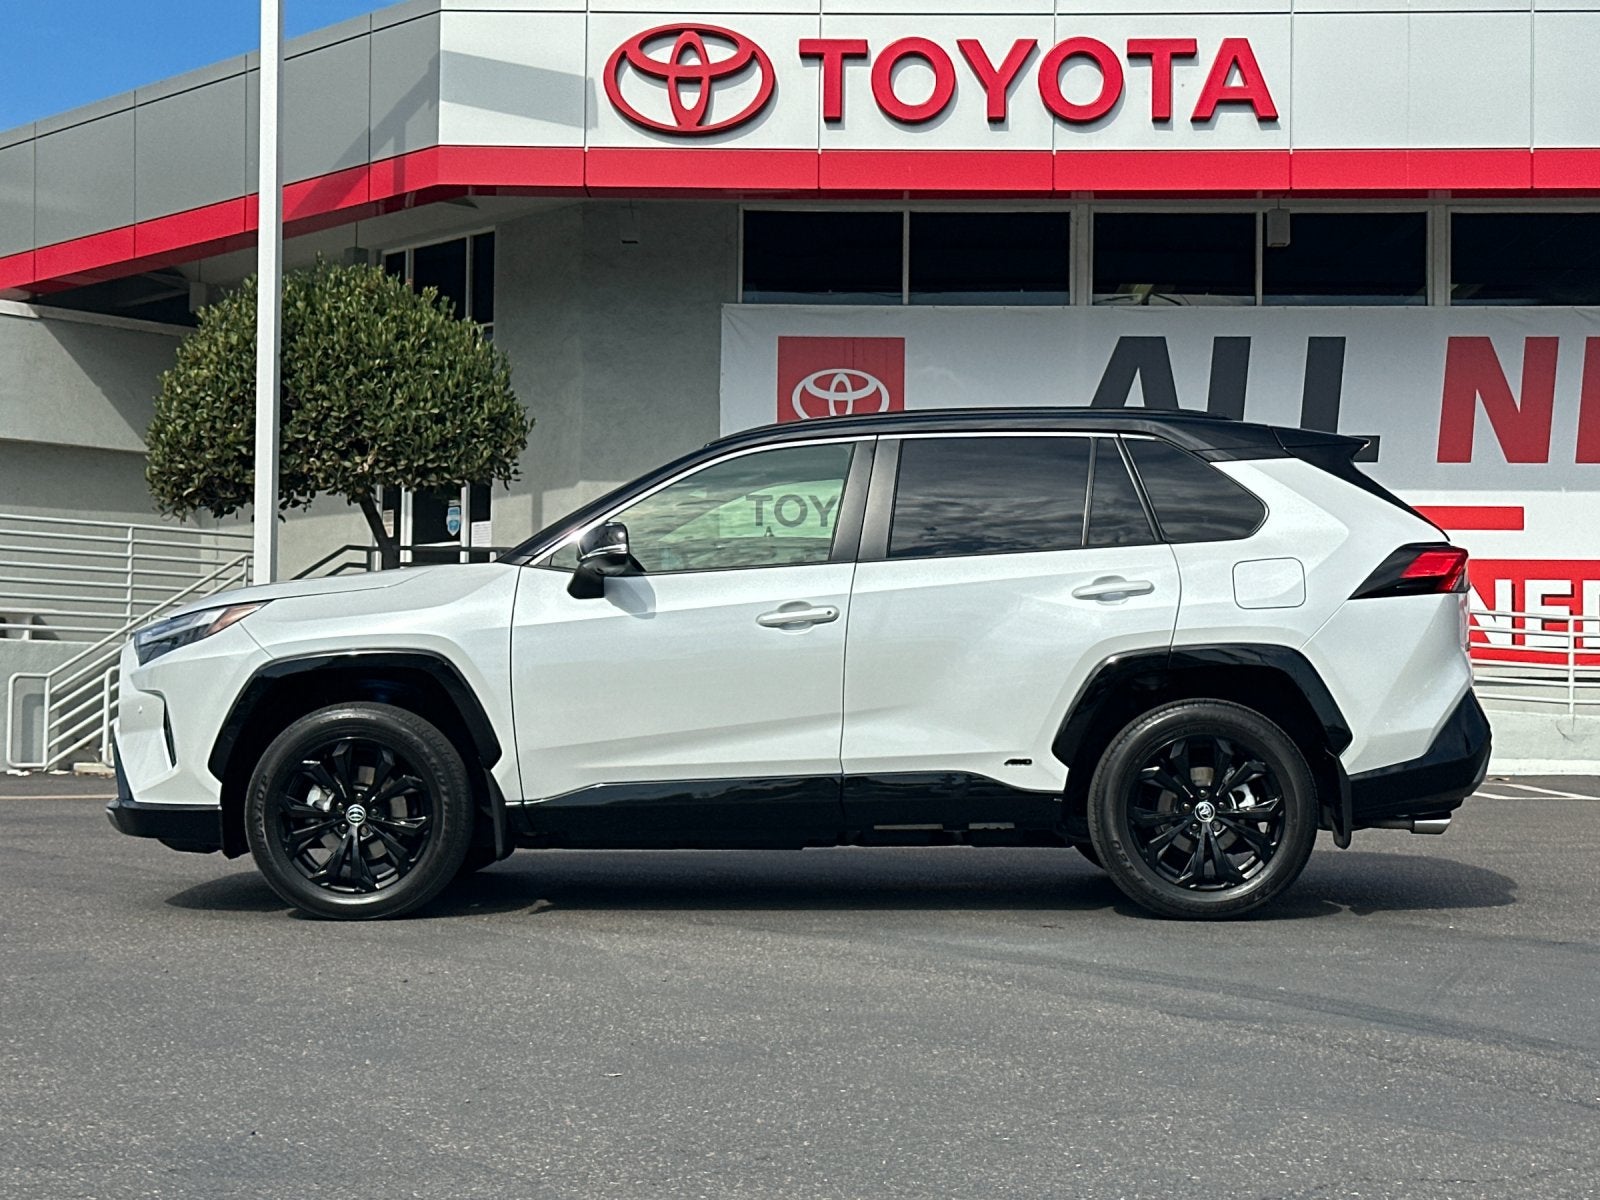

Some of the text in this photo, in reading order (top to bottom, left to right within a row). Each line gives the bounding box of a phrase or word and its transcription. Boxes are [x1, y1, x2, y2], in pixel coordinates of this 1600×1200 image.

[799, 36, 1279, 123] TOYOTA
[1437, 336, 1600, 464] N
[745, 494, 839, 527] TOY
